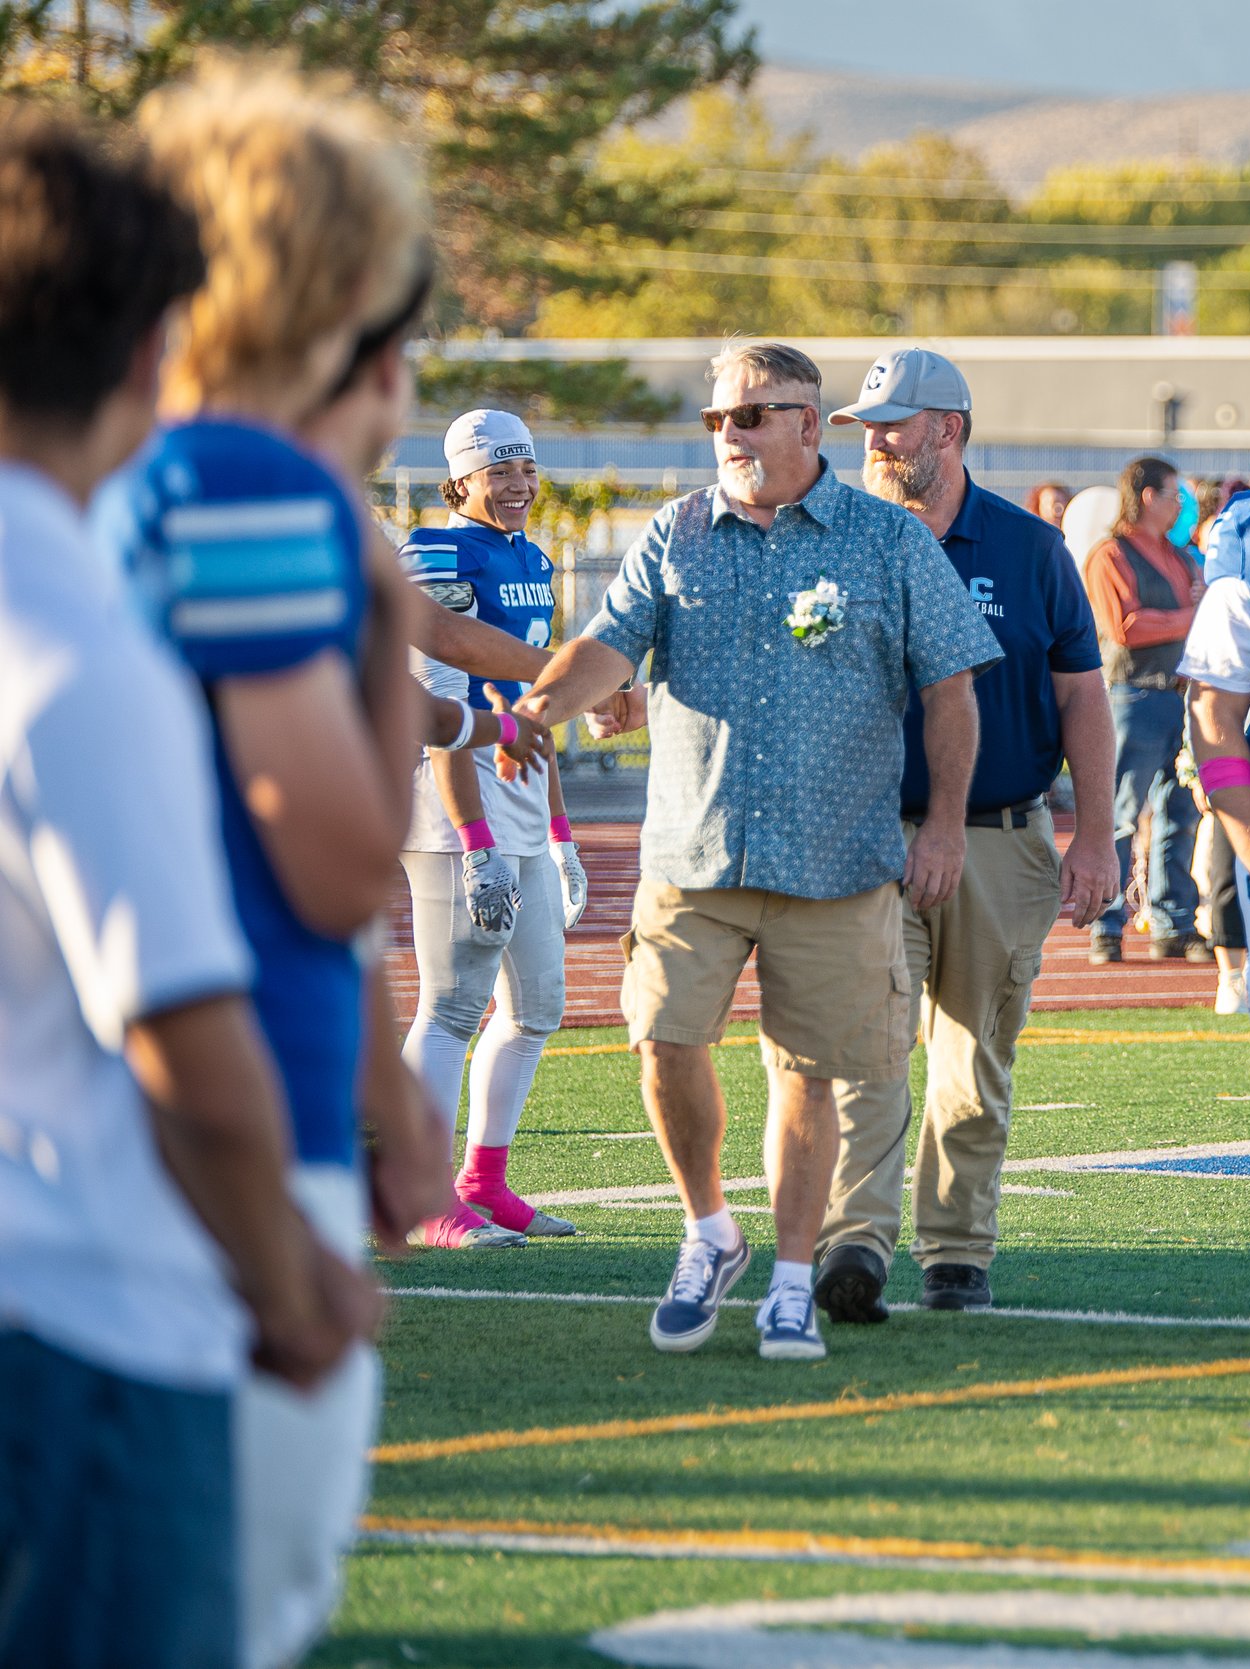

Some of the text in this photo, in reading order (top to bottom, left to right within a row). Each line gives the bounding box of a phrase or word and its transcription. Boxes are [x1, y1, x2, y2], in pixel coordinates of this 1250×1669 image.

[867, 365, 886, 390] C
[499, 583, 554, 607] SENATORS
[970, 577, 994, 601] C
